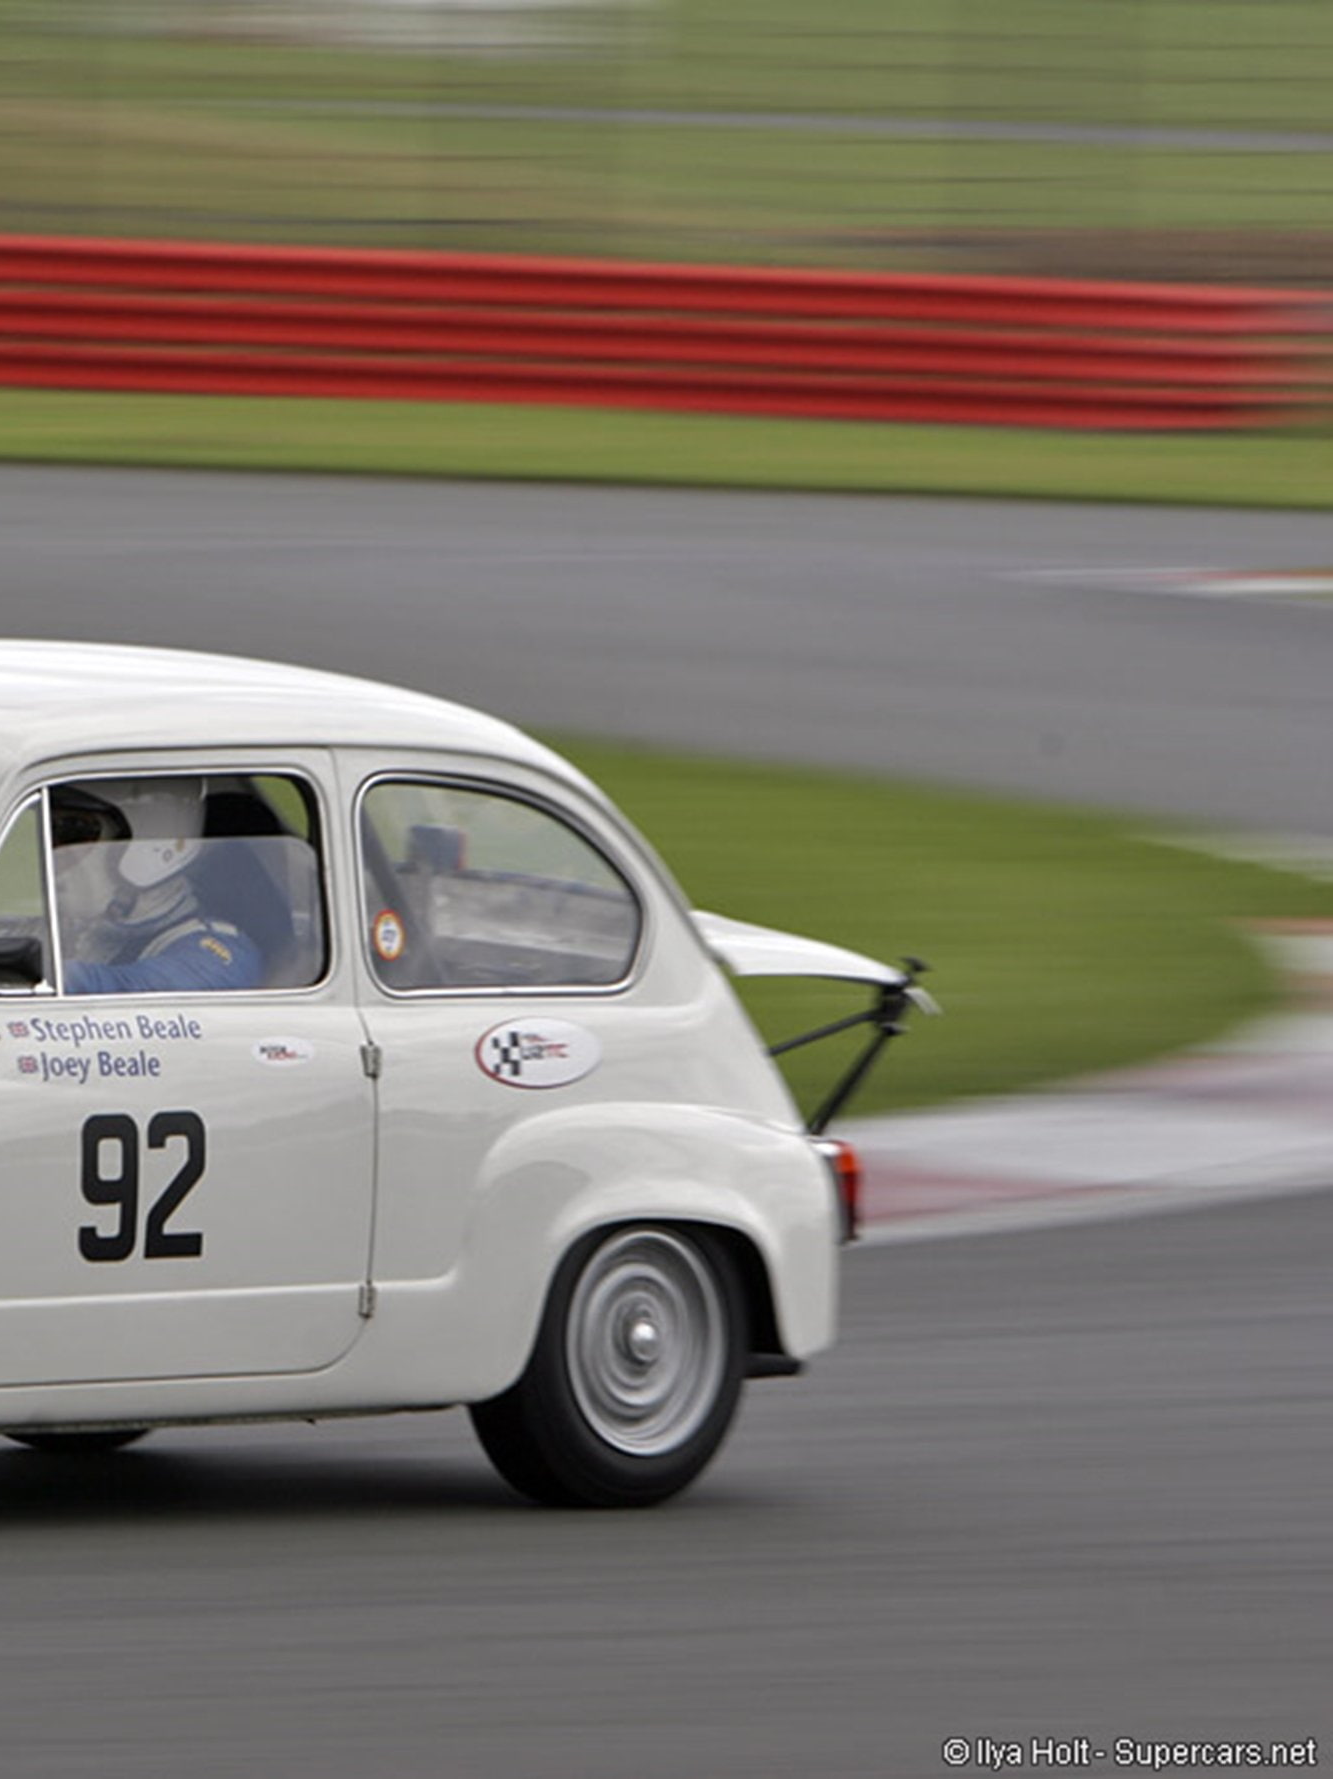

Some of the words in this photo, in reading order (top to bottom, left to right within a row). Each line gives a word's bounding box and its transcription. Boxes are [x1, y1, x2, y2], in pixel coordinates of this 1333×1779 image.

[31, 1016, 133, 1047] Stephen
[136, 1015, 202, 1040] Beale
[40, 1051, 91, 1083] Joey
[98, 1051, 161, 1077] Beale
[78, 1110, 206, 1263] 92
